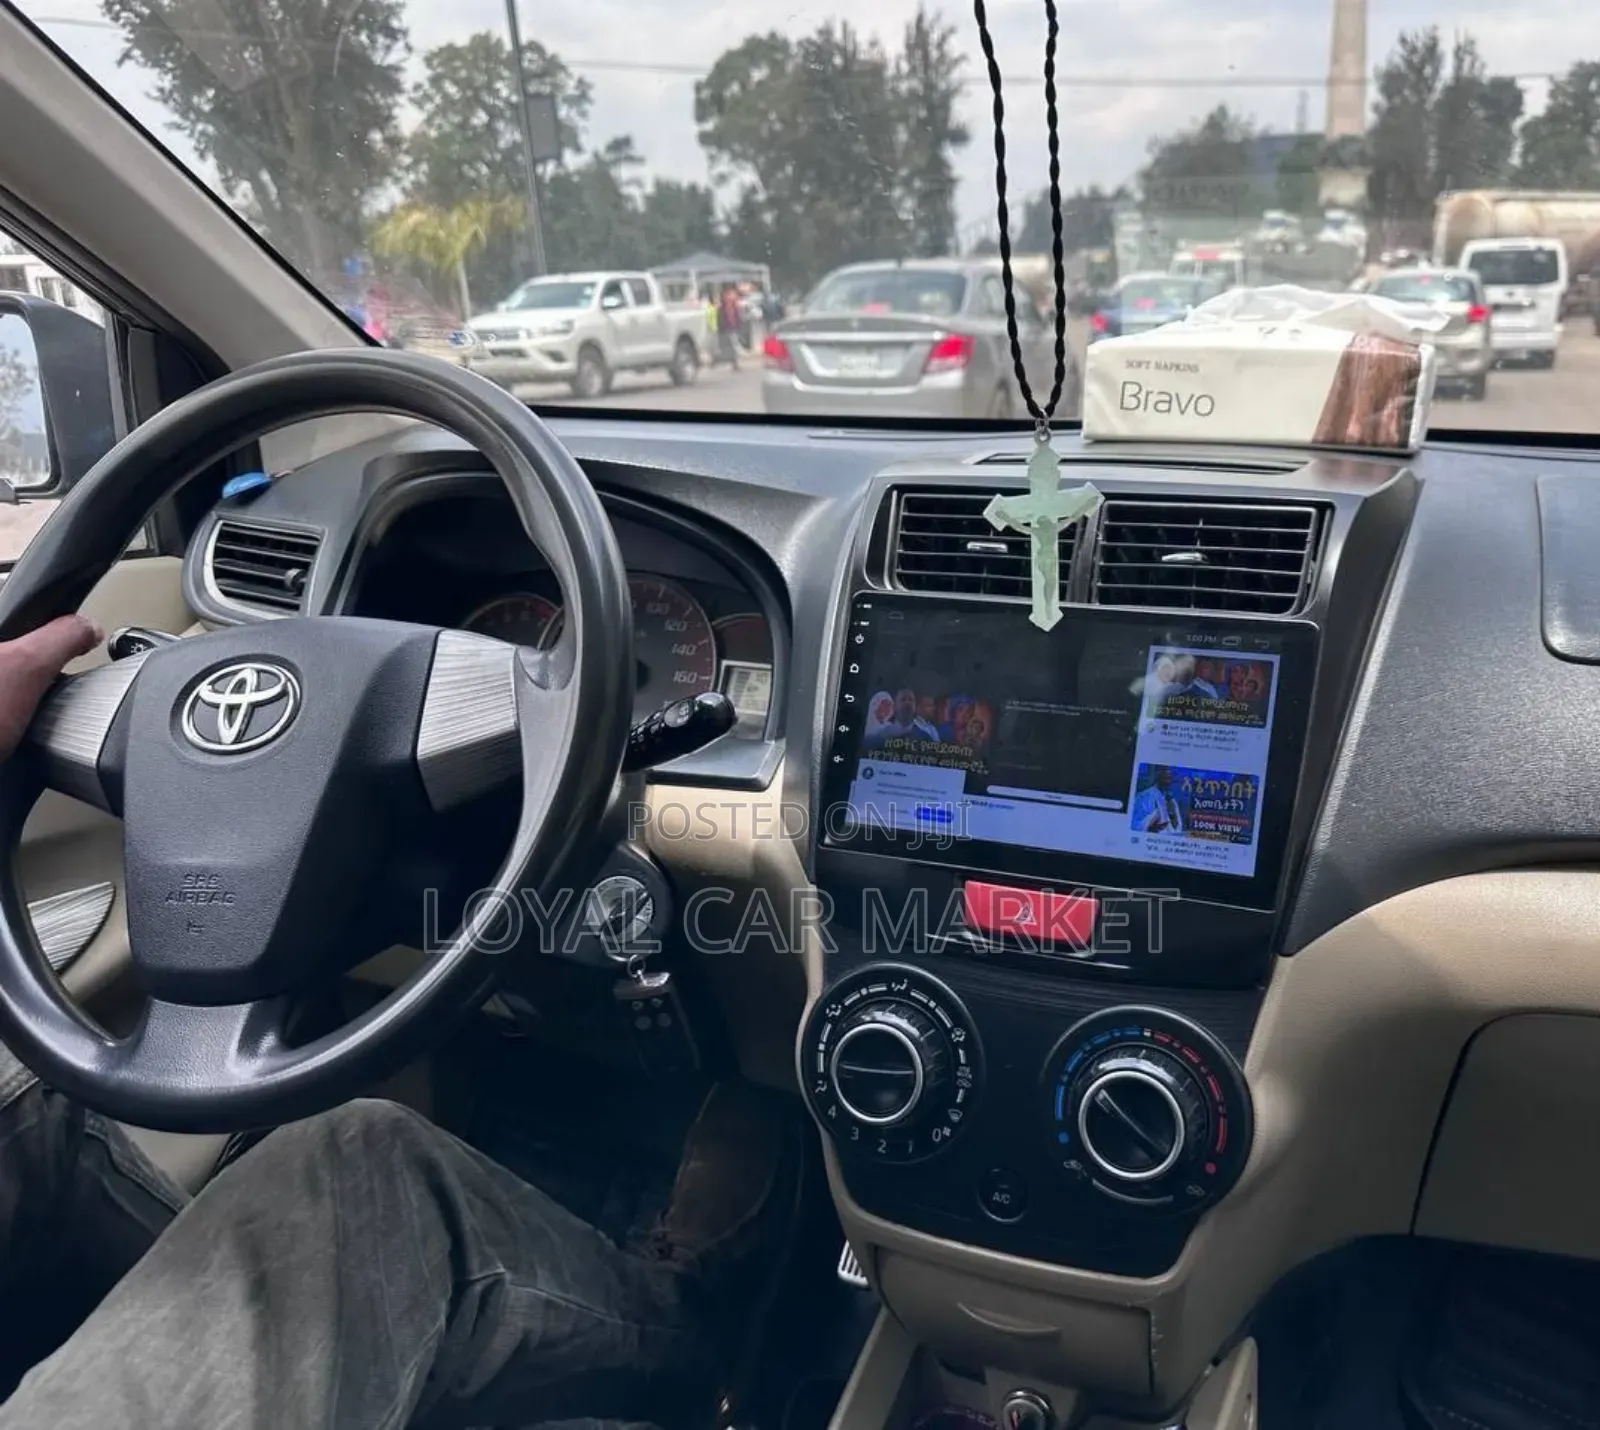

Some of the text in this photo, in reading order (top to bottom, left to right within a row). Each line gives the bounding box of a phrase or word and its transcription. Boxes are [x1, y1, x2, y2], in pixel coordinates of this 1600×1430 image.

[1125, 359, 1200, 374] SOFT NAPKINS
[1120, 380, 1215, 417] Bravo
[664, 622, 689, 633] 120
[671, 643, 698, 656] 140
[672, 670, 698, 685] 160
[164, 891, 237, 906] AIRBAG
[827, 1104, 837, 1119] 4
[850, 1126, 859, 1140] 3
[932, 1127, 942, 1142] 0
[877, 1139, 887, 1154] 2
[907, 1140, 914, 1154] 1
[992, 1191, 1010, 1205] A/C
